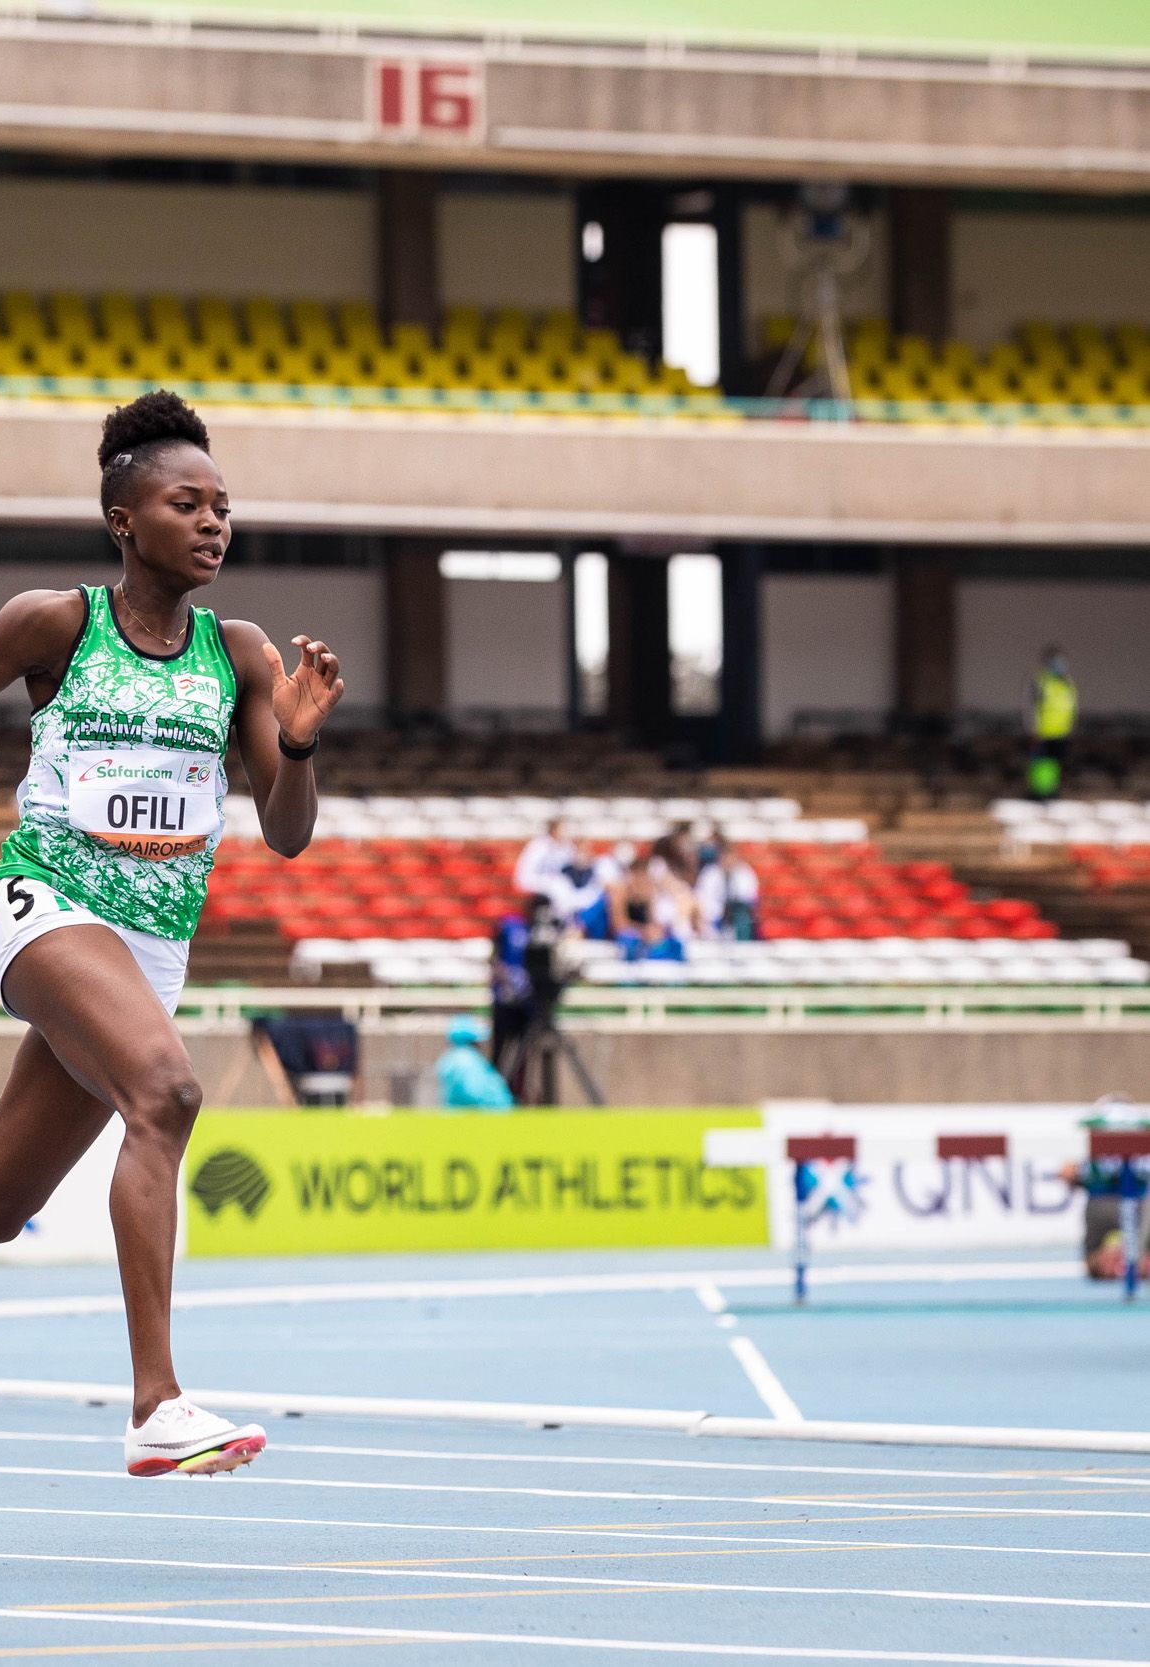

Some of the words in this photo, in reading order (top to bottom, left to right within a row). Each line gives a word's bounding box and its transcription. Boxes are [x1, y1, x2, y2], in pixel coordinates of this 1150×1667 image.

[377, 62, 472, 133] 16
[63, 711, 145, 743] TEAM
[97, 764, 173, 780] Safaricom
[107, 794, 186, 831] OFILI
[6, 875, 35, 921] 5
[290, 1156, 481, 1213] WORLD
[488, 1155, 757, 1212] ATHLETICS
